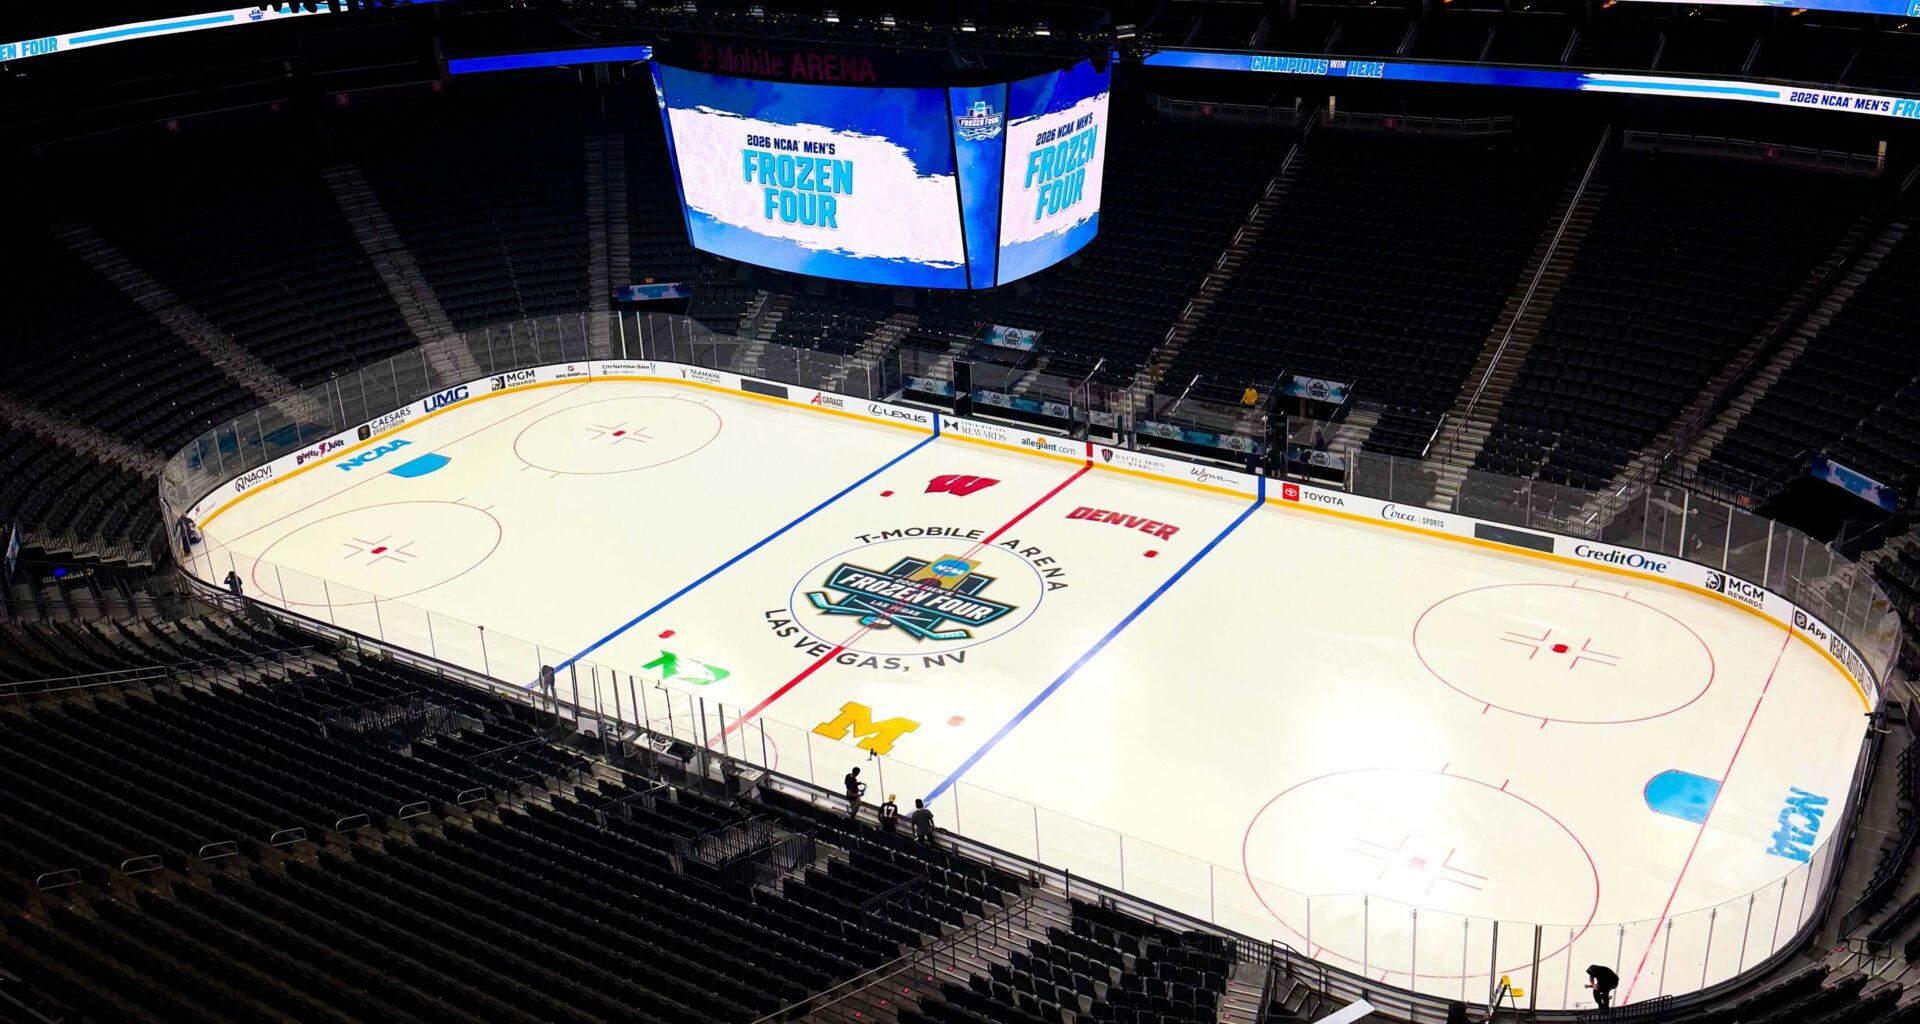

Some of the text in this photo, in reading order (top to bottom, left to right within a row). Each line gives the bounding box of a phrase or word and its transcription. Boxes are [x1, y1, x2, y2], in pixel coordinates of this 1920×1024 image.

[22, 36, 58, 57] FOUR
[791, 52, 879, 83] ARENA
[1251, 55, 1384, 78] CHAMPIONS WIN HERE
[1790, 91, 1819, 104] 2026
[1821, 94, 1850, 108] NCAA
[1854, 98, 1890, 112] MEN'S
[1036, 112, 1094, 146] 2026 NCAA MEN'S
[747, 134, 836, 155] 2026 NCAA MEN'S
[1024, 124, 1098, 188] FROZEN
[743, 148, 853, 195] FROZEN
[1036, 168, 1086, 221] FOUR
[764, 187, 838, 229] FOUR
[506, 369, 535, 382] MGM
[423, 386, 469, 413] UMC
[822, 396, 844, 407] GARAGE
[372, 407, 411, 429] CAESARS
[372, 418, 405, 436] SPORTSBOOK
[883, 409, 927, 423] LEXUS
[962, 426, 1007, 440] REWARDS
[336, 439, 414, 471] NCAA
[1021, 438, 1076, 455] allegiant.com
[244, 465, 272, 484] NAQVI
[1303, 491, 1344, 506] TOYOTA
[1064, 505, 1180, 542] DENVER
[1382, 504, 1444, 528] Circa SPORTS
[855, 527, 1068, 592] T-MOBILE ARENA
[838, 573, 995, 620] FROZEN FOUR
[1728, 591, 1763, 610] REWARDS
[1729, 578, 1765, 602] MGM
[870, 599, 890, 609] LAS
[765, 608, 799, 638] LAS
[923, 651, 966, 668] NV
[883, 805, 895, 818] 17
[1766, 786, 1830, 864] NCAA
